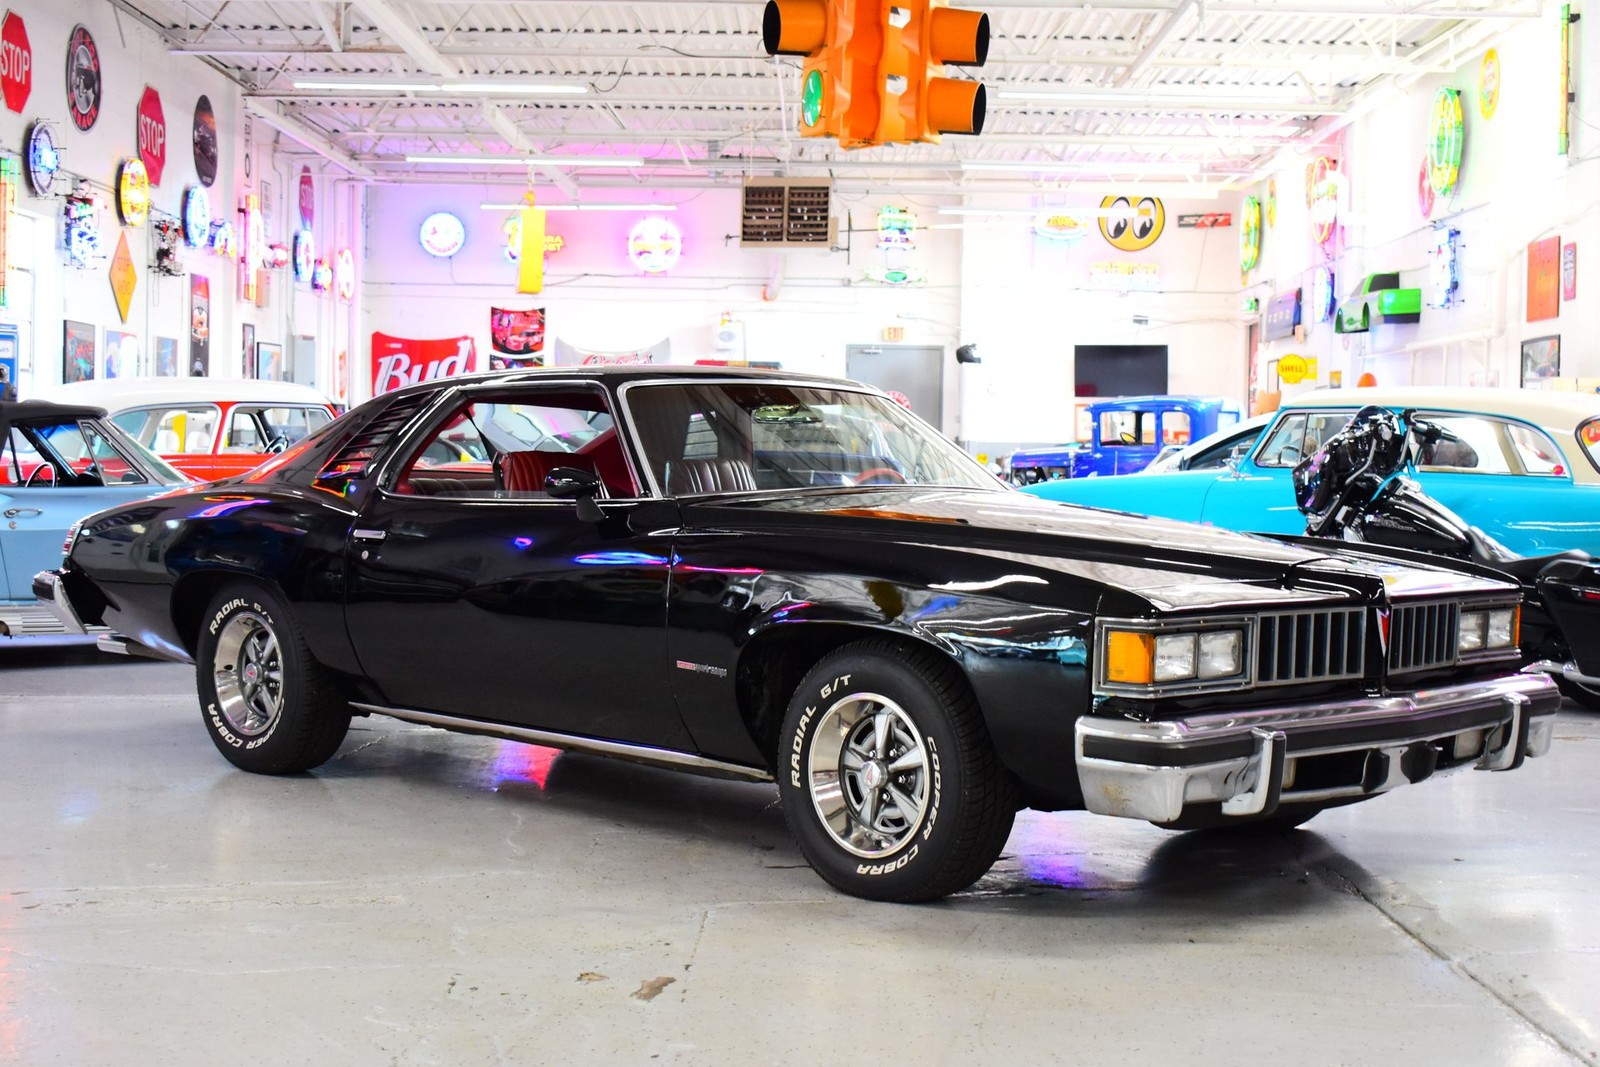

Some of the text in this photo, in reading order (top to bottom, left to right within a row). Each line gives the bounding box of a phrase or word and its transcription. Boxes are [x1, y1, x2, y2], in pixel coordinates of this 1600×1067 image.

[1, 40, 30, 85] STOP
[139, 112, 165, 159] STOP
[888, 327, 904, 339] EXIT
[374, 339, 472, 396] Bud
[1280, 365, 1303, 373] SHELL
[209, 598, 274, 635] RADIAL G/T
[208, 703, 243, 749] COBRA
[791, 674, 852, 788] RADIAL G/T
[857, 736, 942, 875] COOPER COBRA
